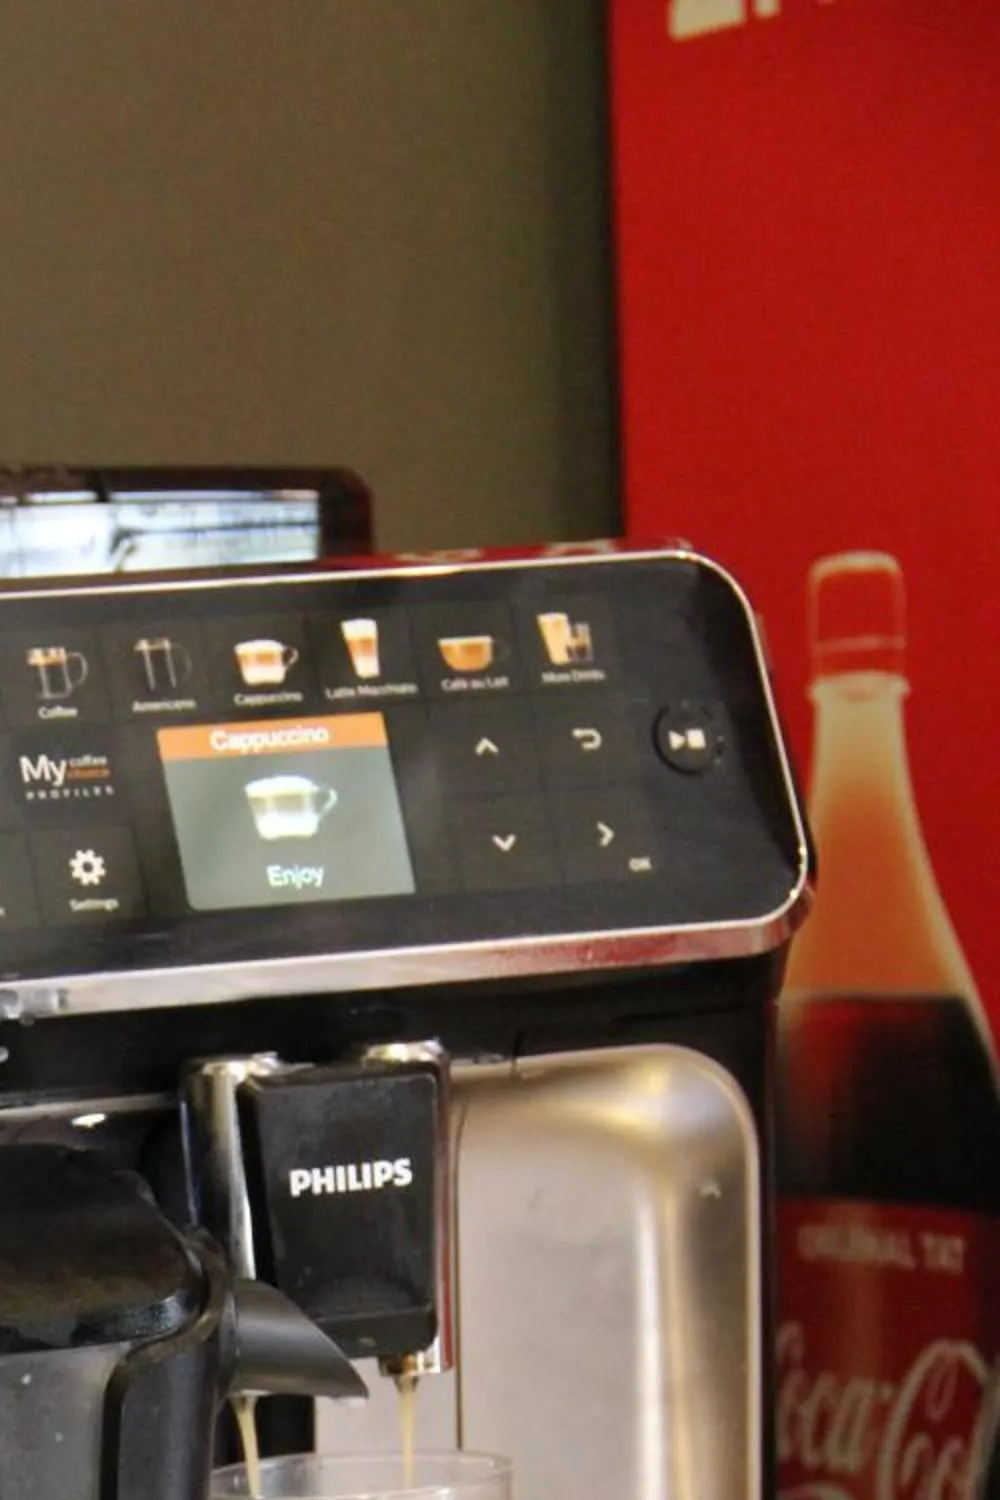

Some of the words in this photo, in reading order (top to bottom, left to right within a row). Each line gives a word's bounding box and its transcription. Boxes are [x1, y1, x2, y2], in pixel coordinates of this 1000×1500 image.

[38, 705, 78, 720] Coffee
[210, 724, 330, 755] Cappuccino
[19, 753, 67, 787] My
[266, 864, 325, 889] Enjoy
[288, 1157, 413, 1197] PHILIPS
